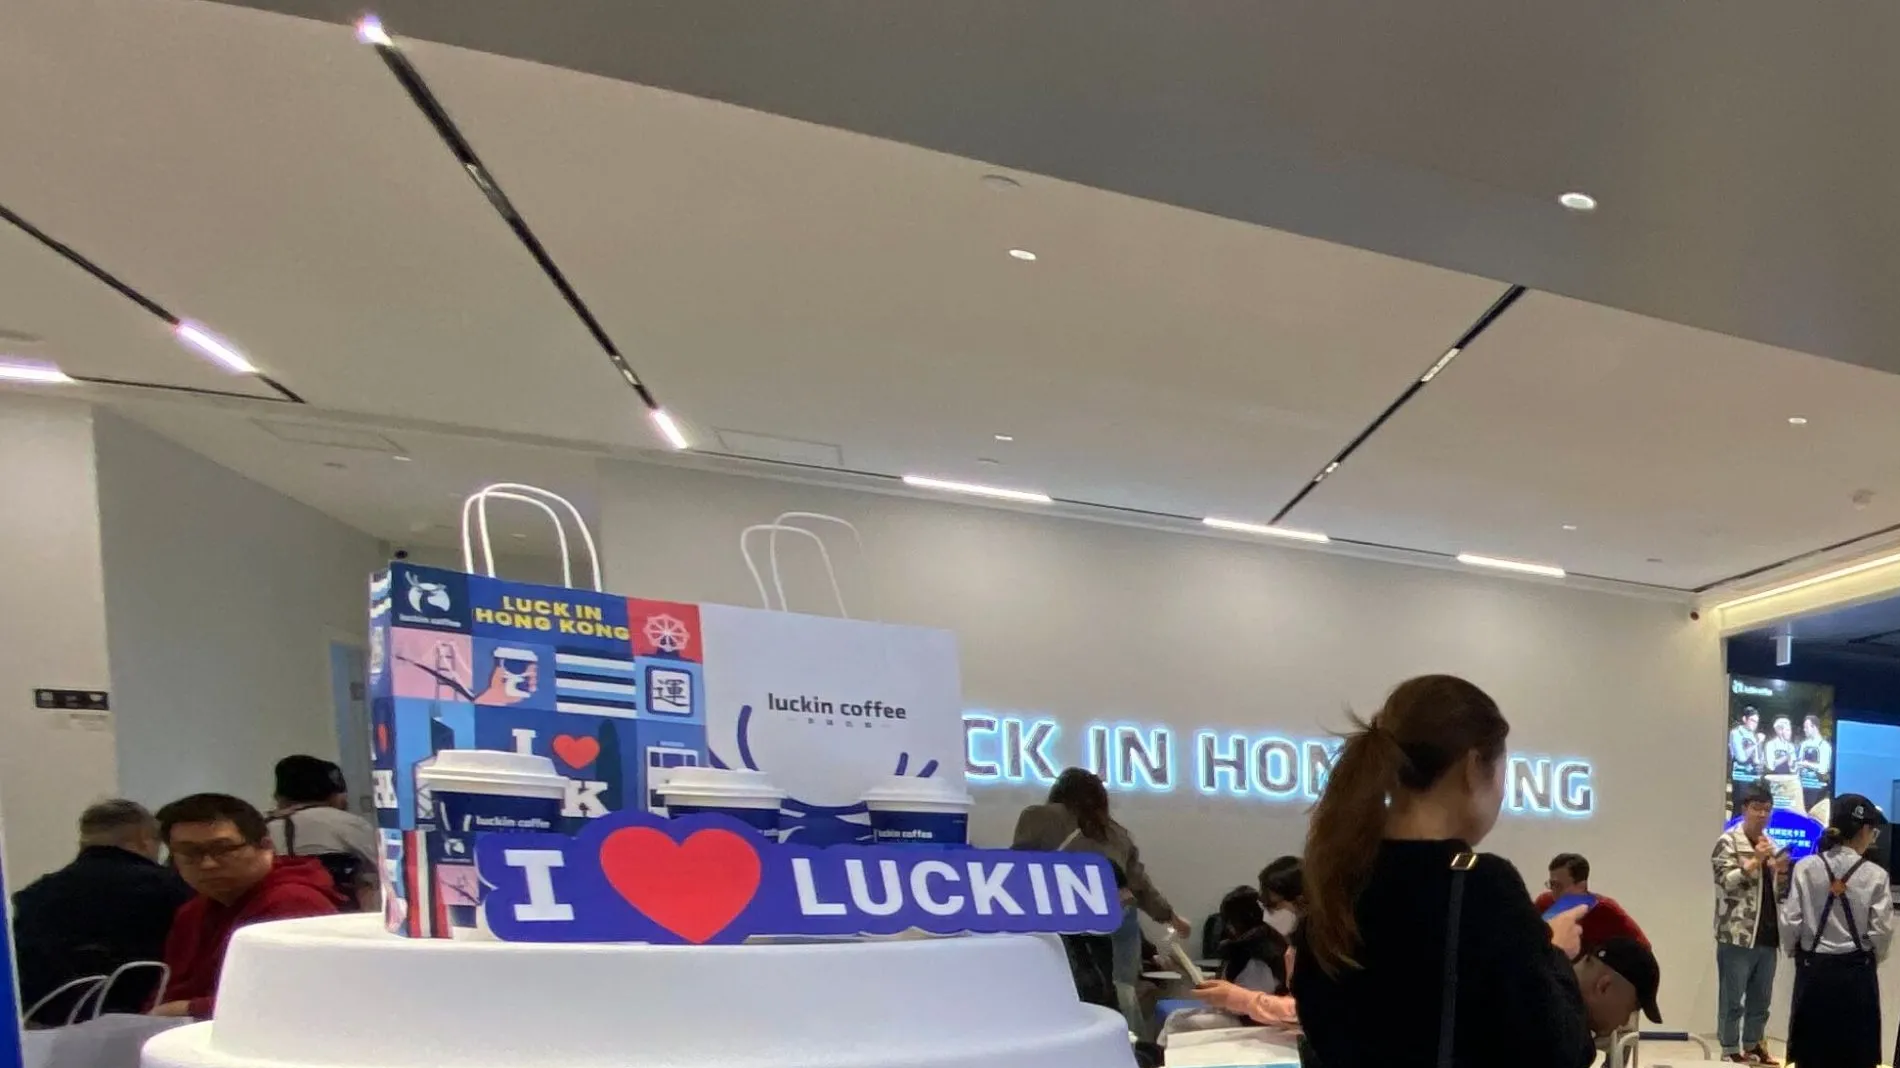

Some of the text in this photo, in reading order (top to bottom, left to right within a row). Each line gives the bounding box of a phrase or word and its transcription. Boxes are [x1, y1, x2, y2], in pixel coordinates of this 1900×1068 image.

[475, 608, 630, 641] HONG KONG
[503, 596, 602, 621] LUCK IN
[768, 692, 906, 719] luckin coffee
[962, 714, 1593, 815] CK IN HON NG
[561, 779, 612, 818] K
[504, 849, 575, 922] I
[791, 856, 1110, 918] LUCKIN
